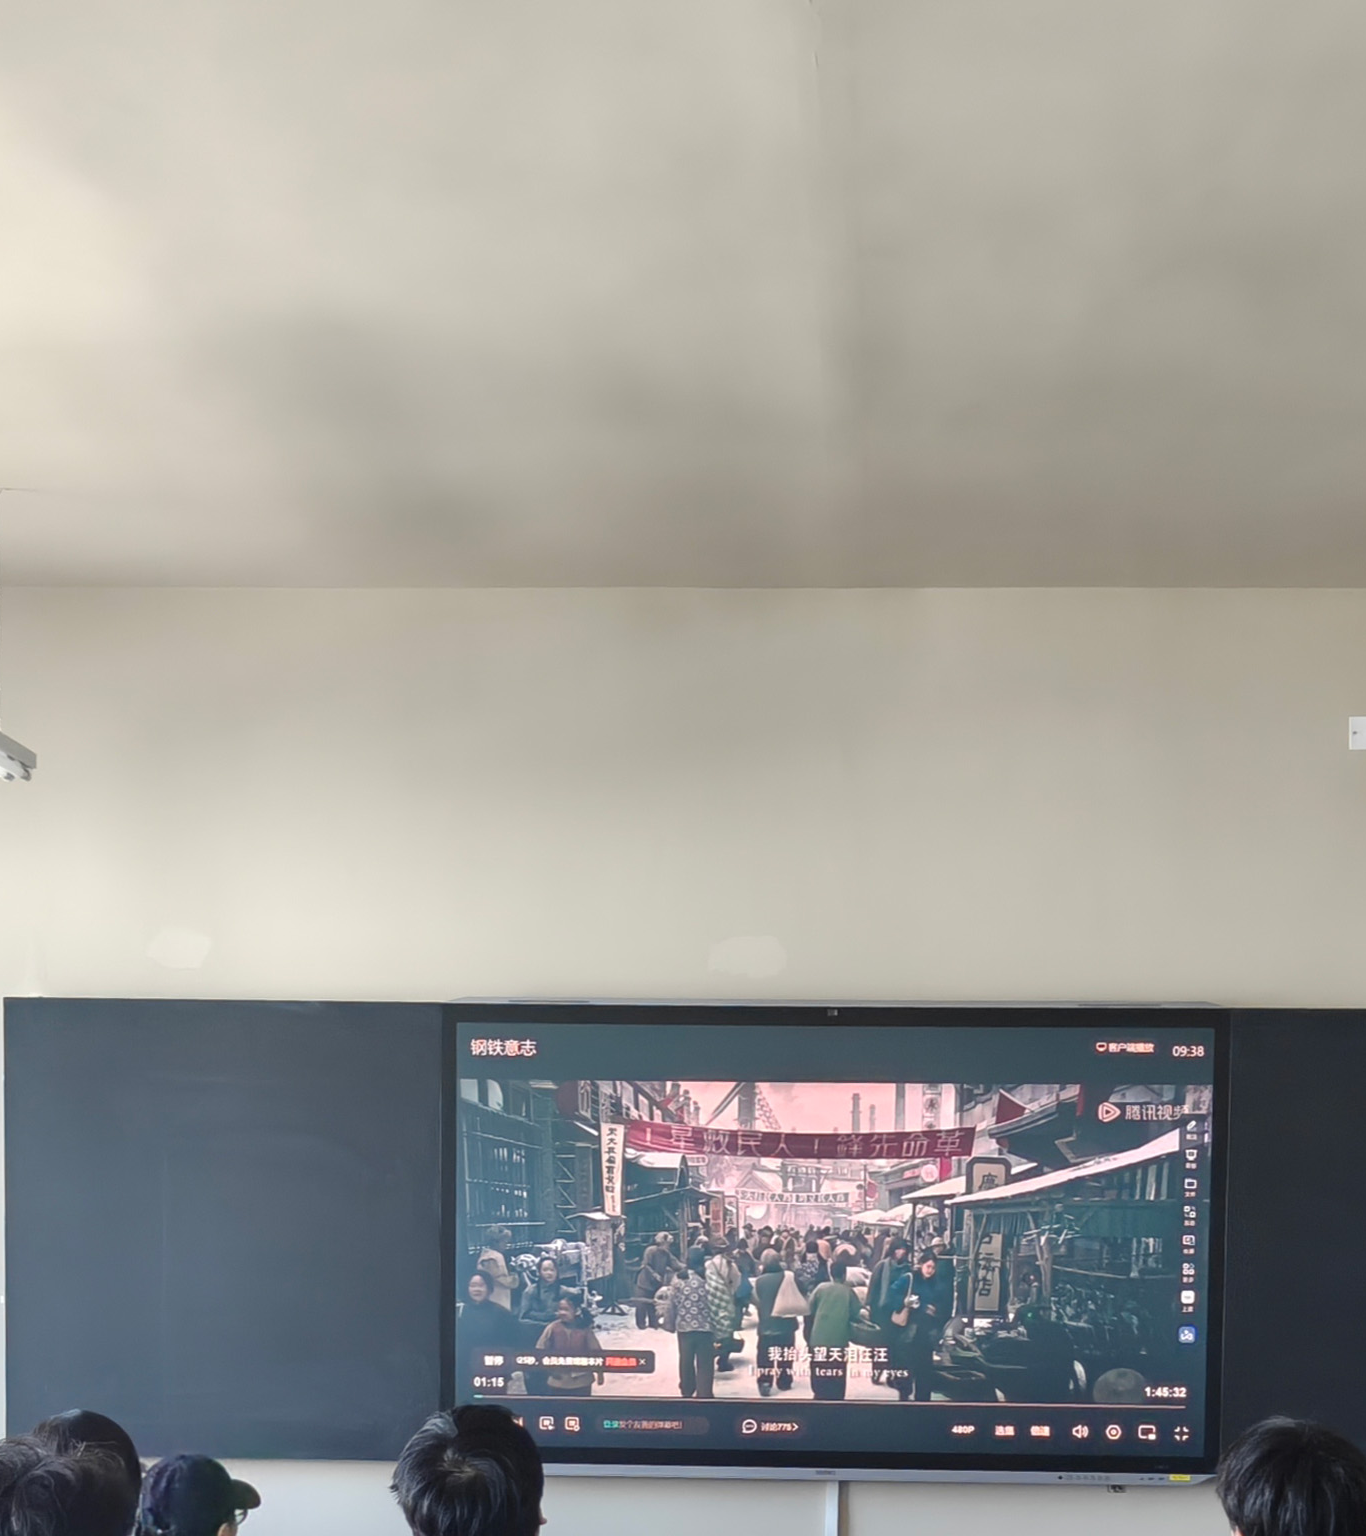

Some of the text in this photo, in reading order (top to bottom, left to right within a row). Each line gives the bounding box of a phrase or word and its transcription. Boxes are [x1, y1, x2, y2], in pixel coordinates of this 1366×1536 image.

[470, 1038, 537, 1056] 钢铁意志
[1172, 1045, 1205, 1057] 09:38
[1125, 1104, 1189, 1121] 腾讯视频
[767, 1347, 888, 1363] 我抬头望天泪汪汪
[757, 1367, 782, 1379] pray
[815, 1367, 843, 1377] tears
[884, 1369, 909, 1380] eyes
[473, 1377, 504, 1387] 01:15
[1144, 1386, 1187, 1397] 1:45:32
[951, 1425, 975, 1434] 480P
